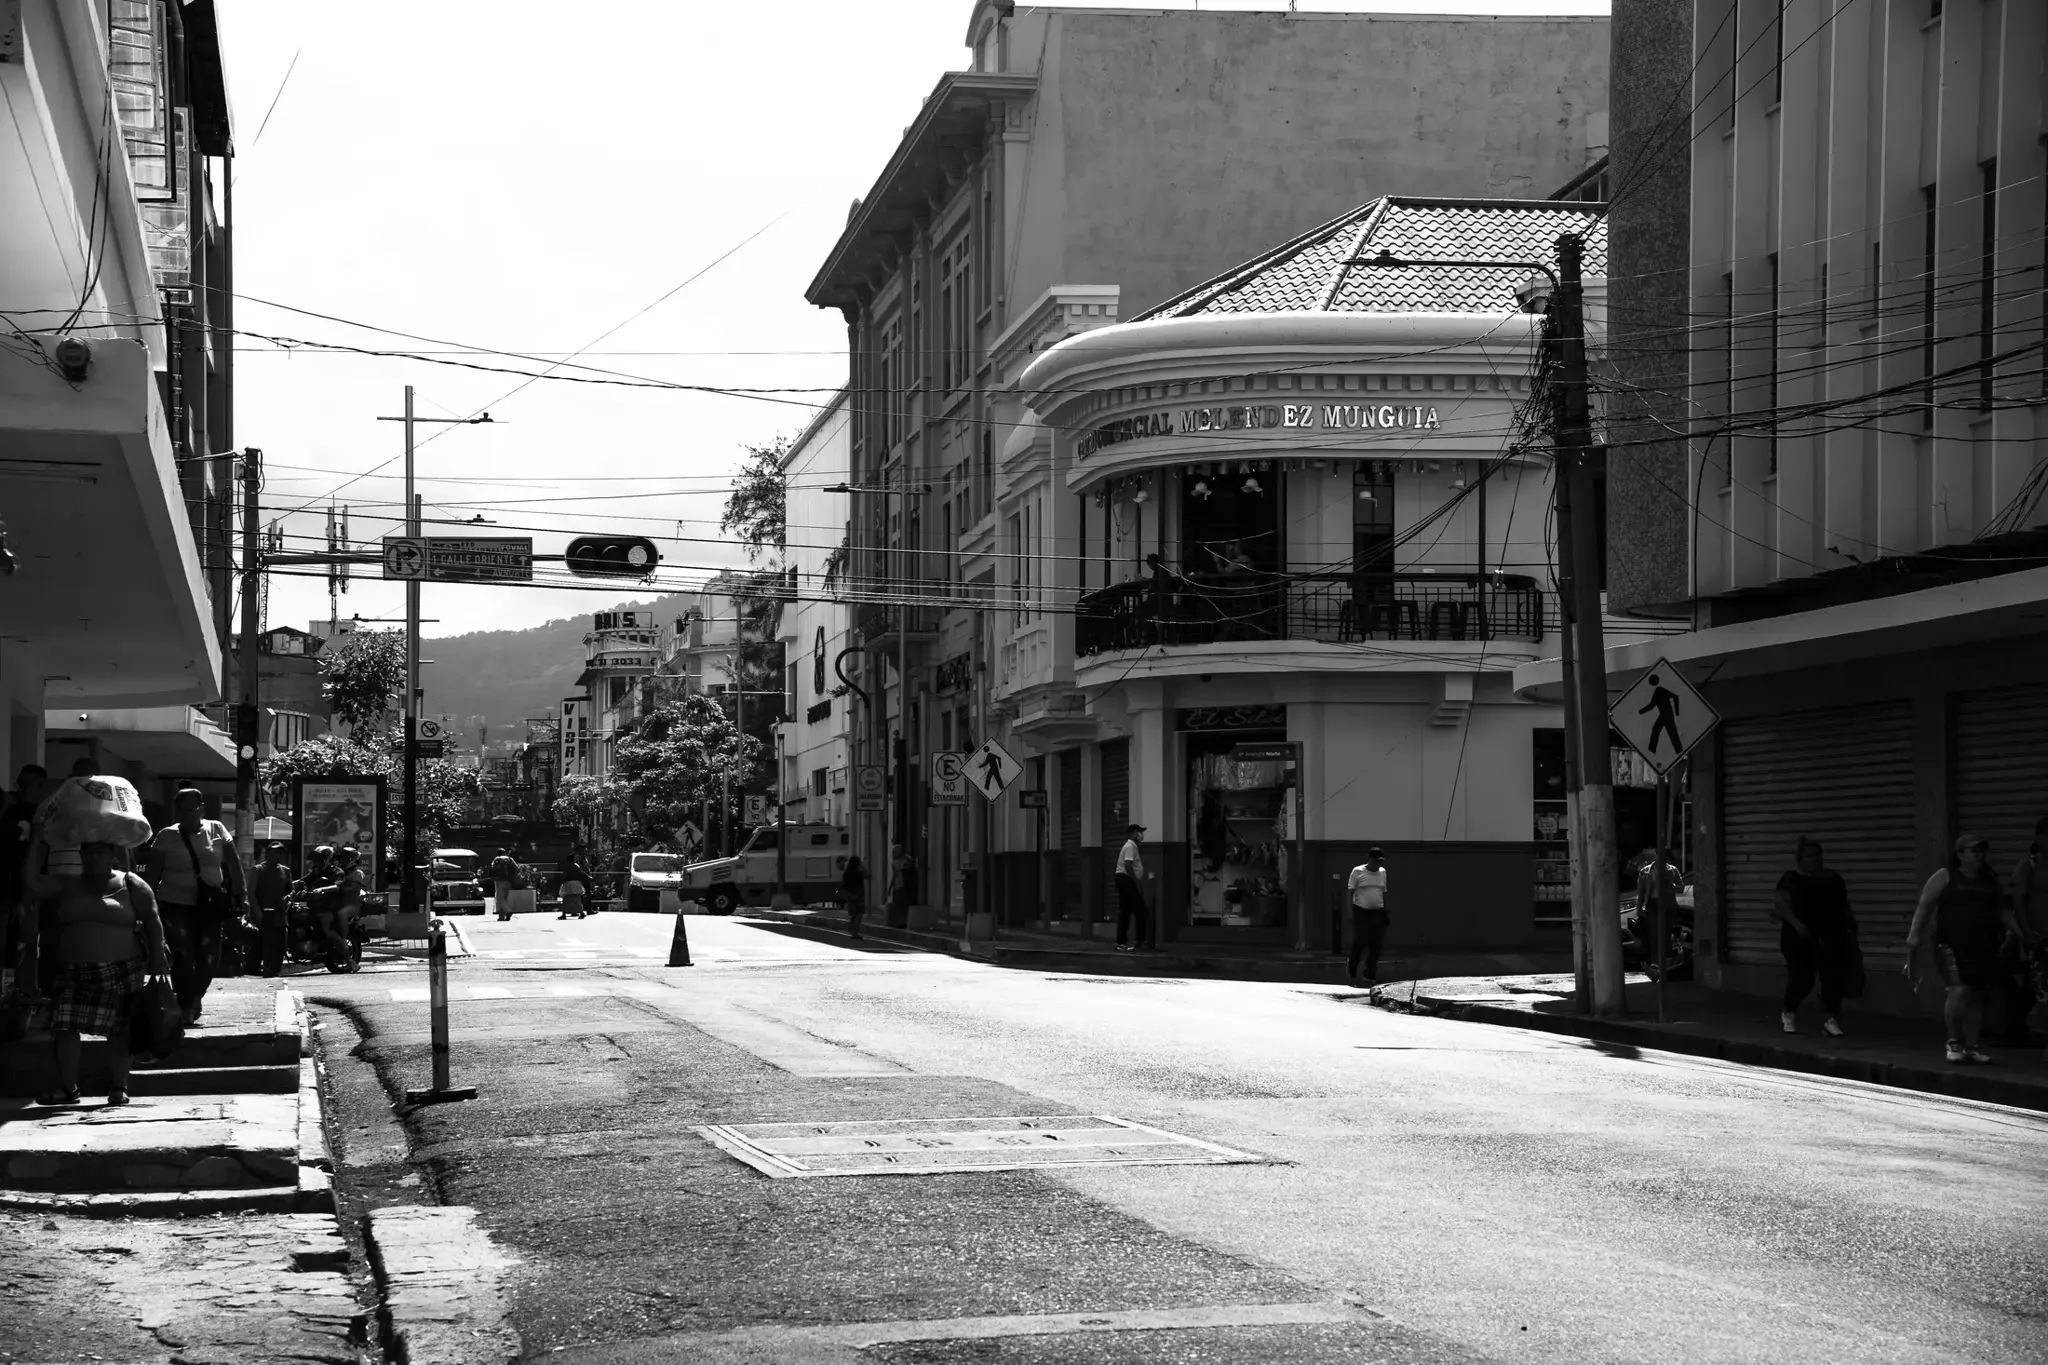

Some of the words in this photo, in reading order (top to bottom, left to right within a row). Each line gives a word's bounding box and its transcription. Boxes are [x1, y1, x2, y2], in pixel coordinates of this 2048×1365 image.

[1179, 405, 1314, 433] MELENDEZ
[1322, 405, 1441, 429] MUNGUIA
[441, 554, 472, 565] CALLE
[474, 554, 515, 565] ORIENTE
[943, 781, 956, 792] NO
